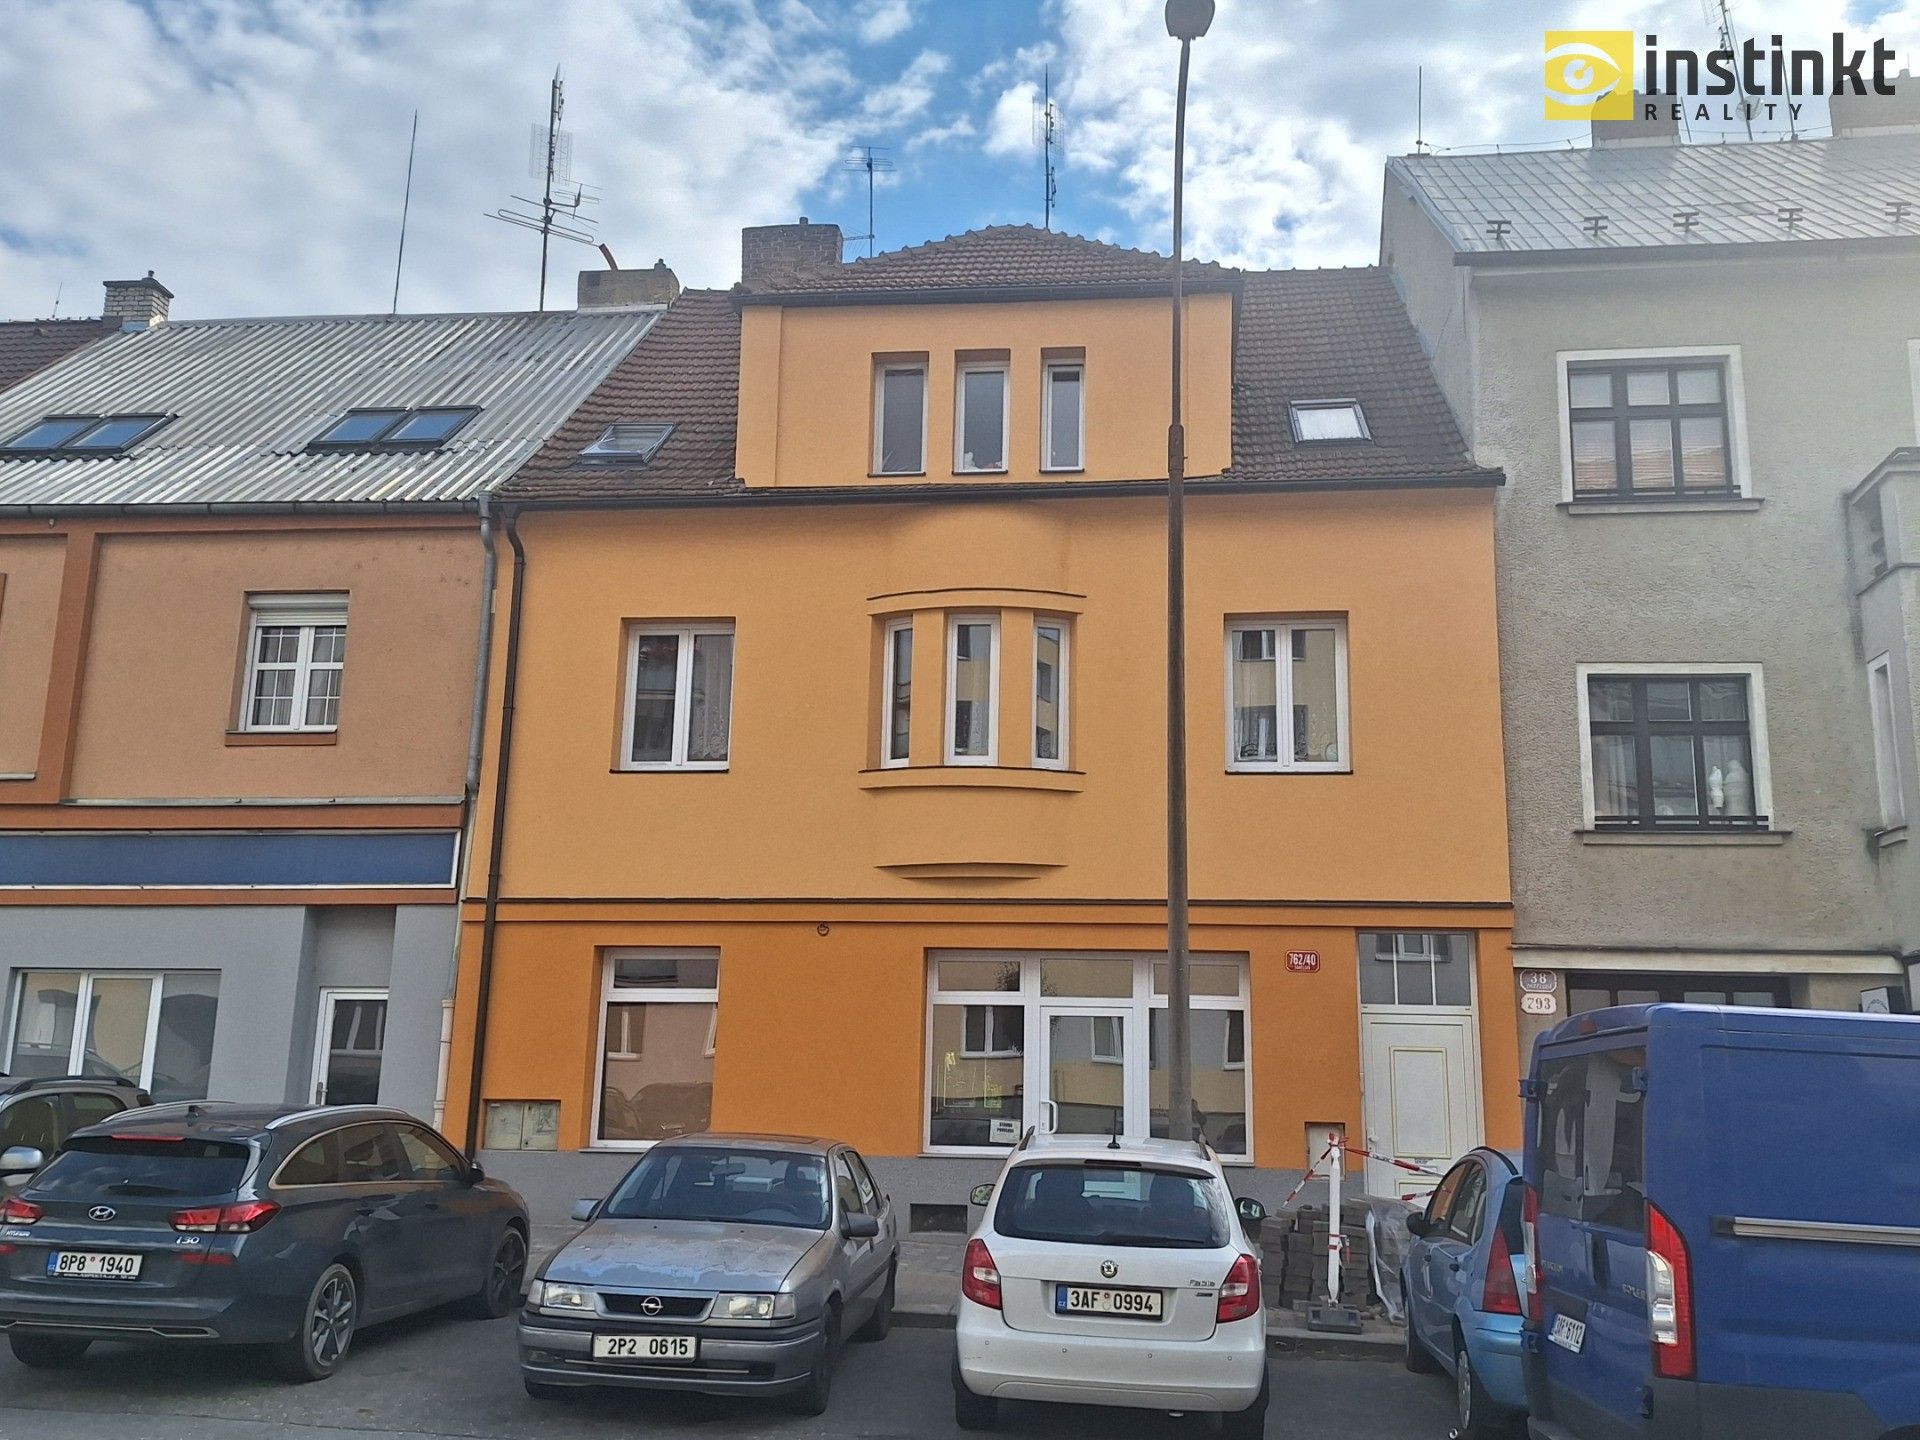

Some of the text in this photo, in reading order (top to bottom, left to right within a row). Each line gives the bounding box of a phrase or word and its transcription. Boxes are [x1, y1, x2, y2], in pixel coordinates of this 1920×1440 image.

[1289, 954, 1316, 965] 762/40
[1530, 972, 1547, 984] 38
[1527, 997, 1551, 1010] 793
[60, 1255, 87, 1271] 8P8
[99, 1256, 134, 1273] 1940
[1071, 1290, 1100, 1309] 3AF
[1113, 1294, 1153, 1312] 0994
[608, 1338, 688, 1356] 2P2 0615
